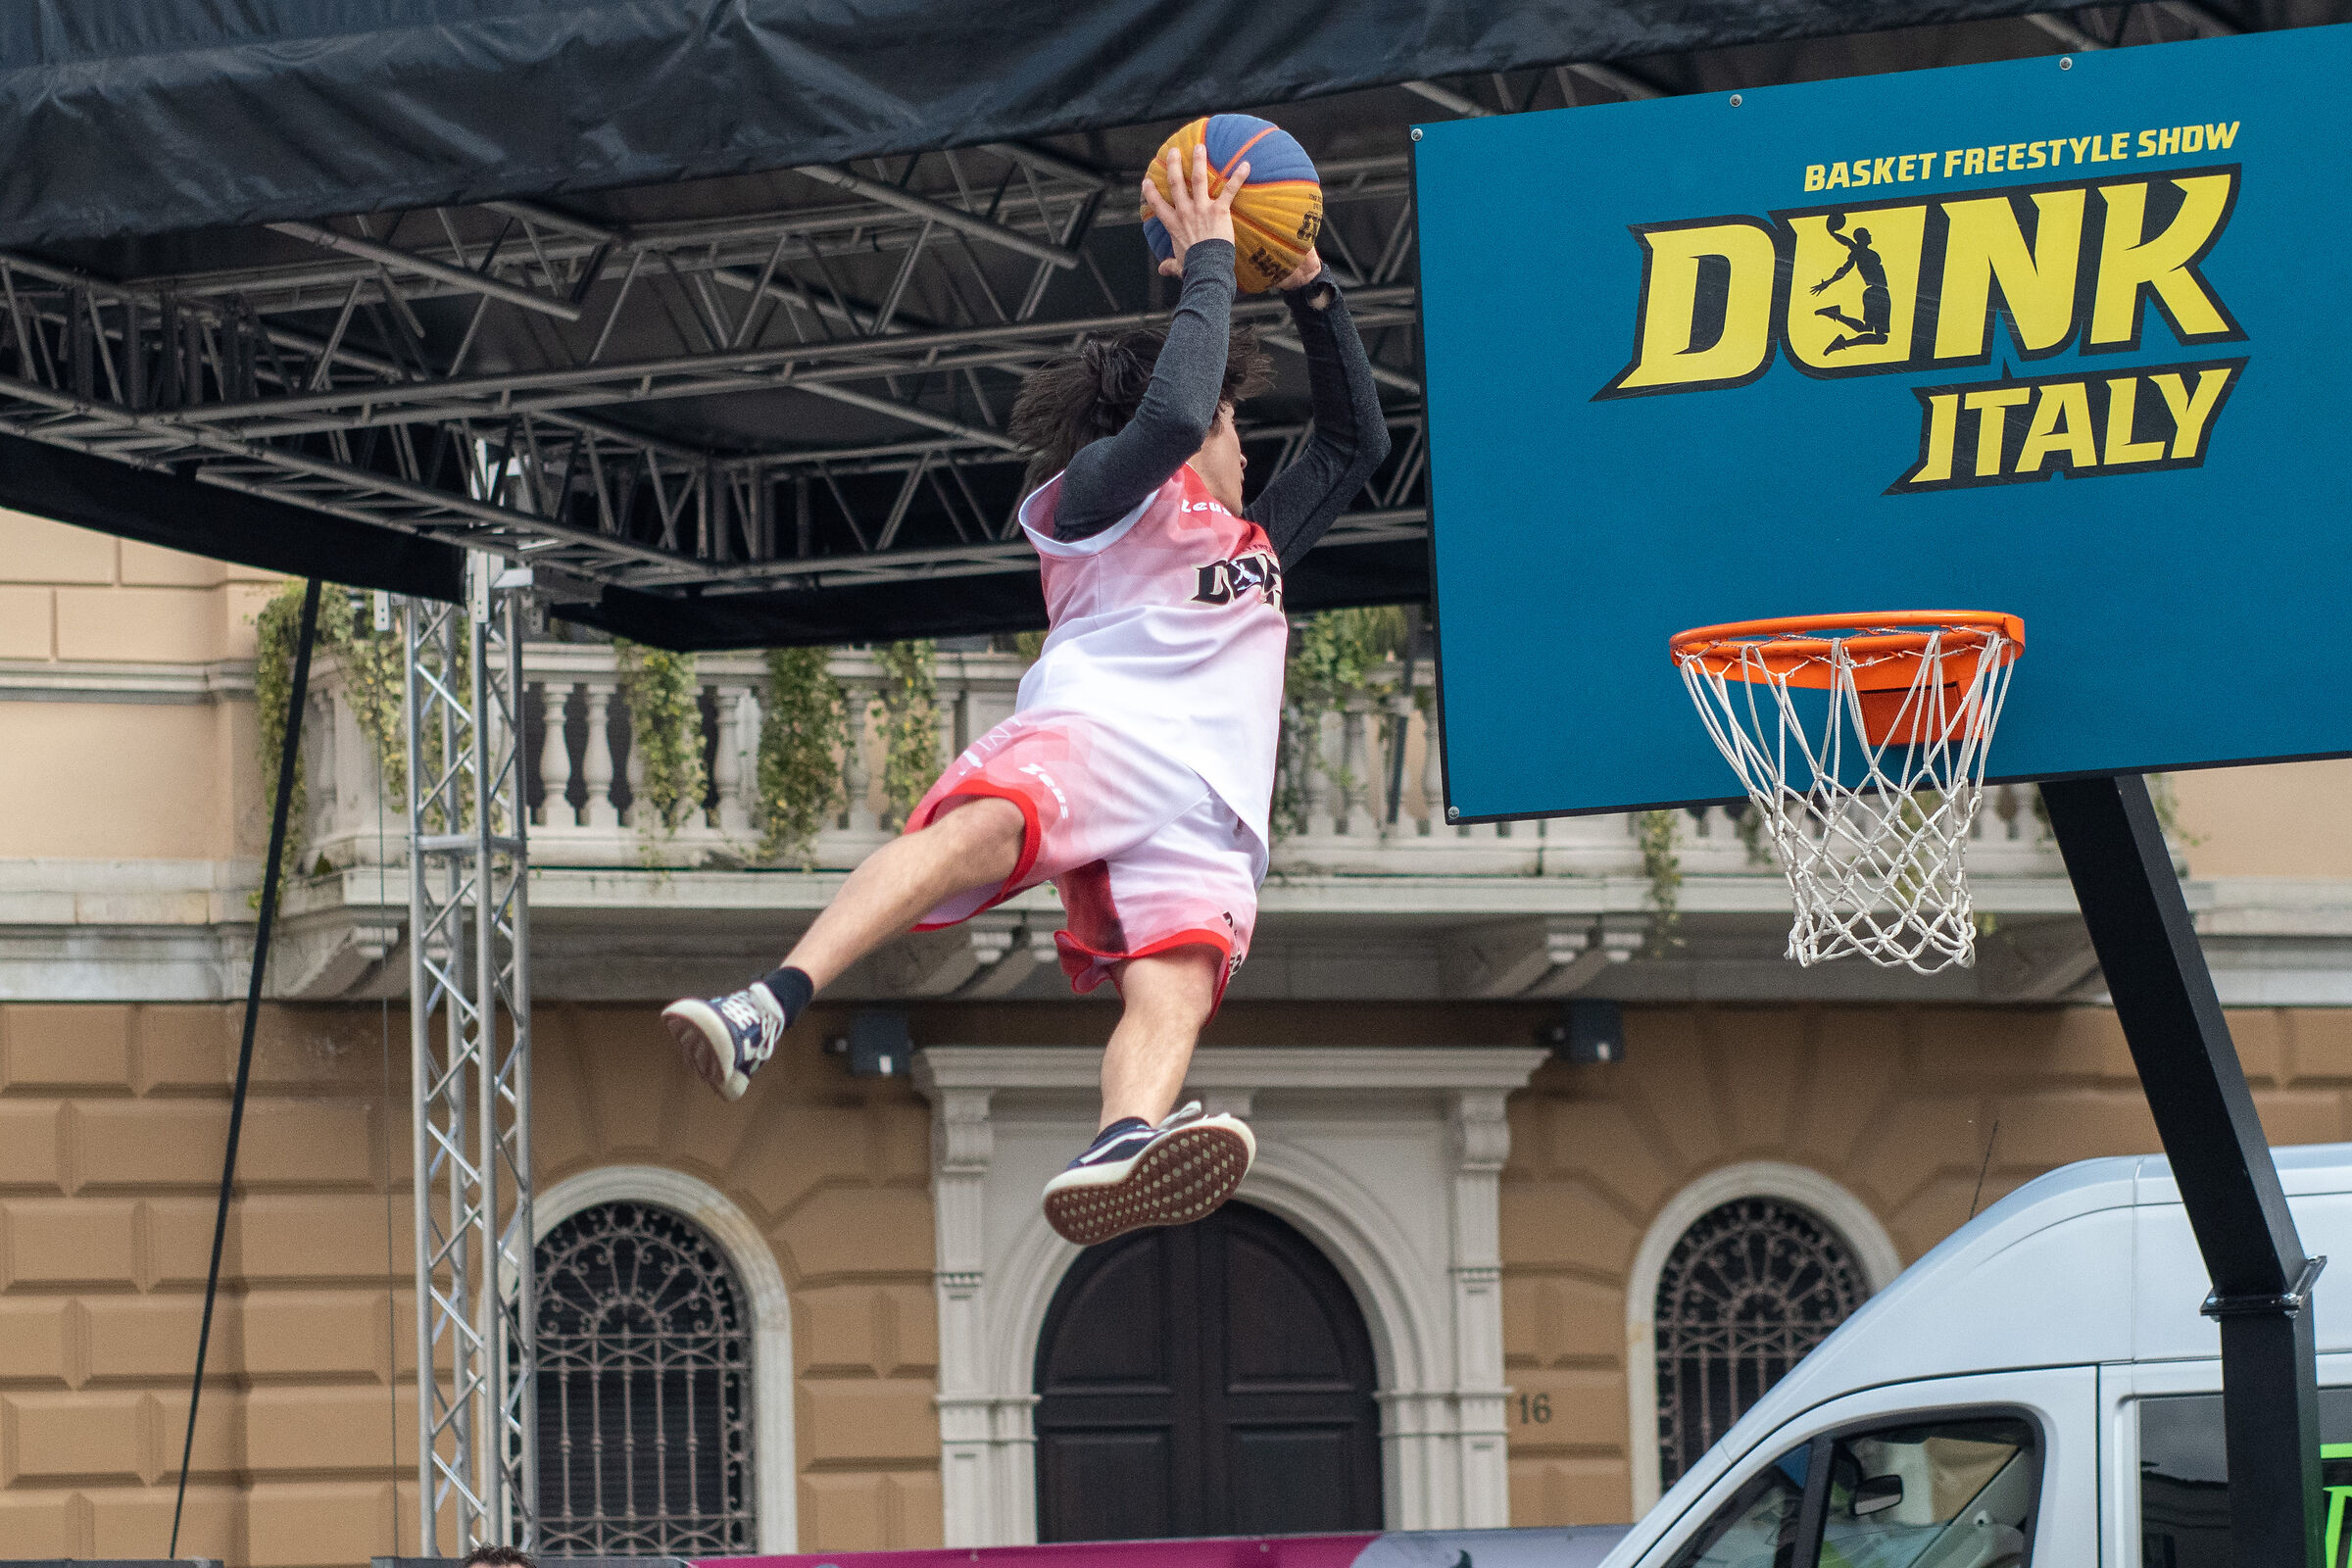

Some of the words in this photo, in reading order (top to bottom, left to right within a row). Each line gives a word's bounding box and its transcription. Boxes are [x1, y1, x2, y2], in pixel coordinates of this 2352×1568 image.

[1803, 152, 1937, 192] BASKET
[1943, 131, 2131, 178] FREESTYLE
[2136, 121, 2241, 158] SHOW
[1616, 173, 2232, 390] DUNK
[1908, 368, 2232, 483] ITALY
[1519, 1392, 1553, 1425] 16
